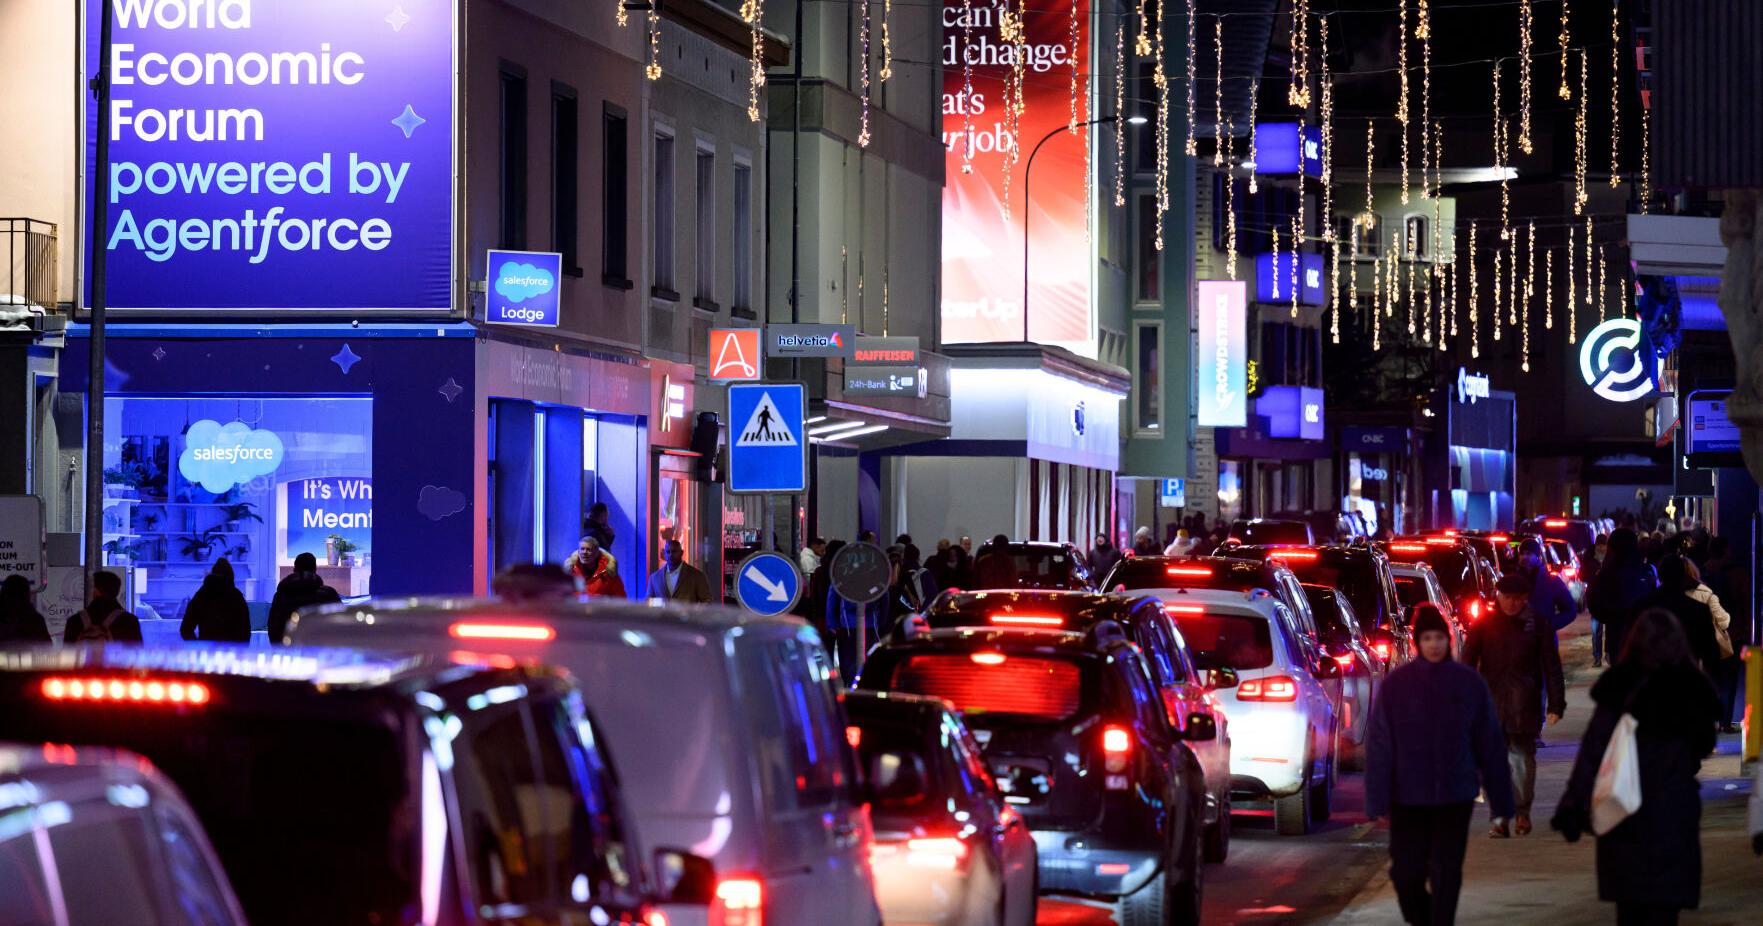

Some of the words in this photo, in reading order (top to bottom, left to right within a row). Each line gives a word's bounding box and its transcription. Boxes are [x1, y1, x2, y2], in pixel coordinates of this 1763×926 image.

[963, 36, 1073, 72] change.
[111, 42, 364, 86] Economic
[111, 99, 264, 142] Forum
[110, 152, 331, 204] powered
[349, 152, 411, 204] by
[106, 206, 392, 264] Agentforce
[503, 276, 548, 287] salesforce
[501, 306, 544, 322] Lodge
[778, 335, 828, 346] helvetia
[854, 350, 915, 361] RAIFFEISEN
[849, 378, 887, 390] 24h-Bank
[193, 445, 273, 465] salesforce
[338, 480, 373, 500] Wh
[1167, 478, 1179, 495] P
[0, 552, 17, 560] UM
